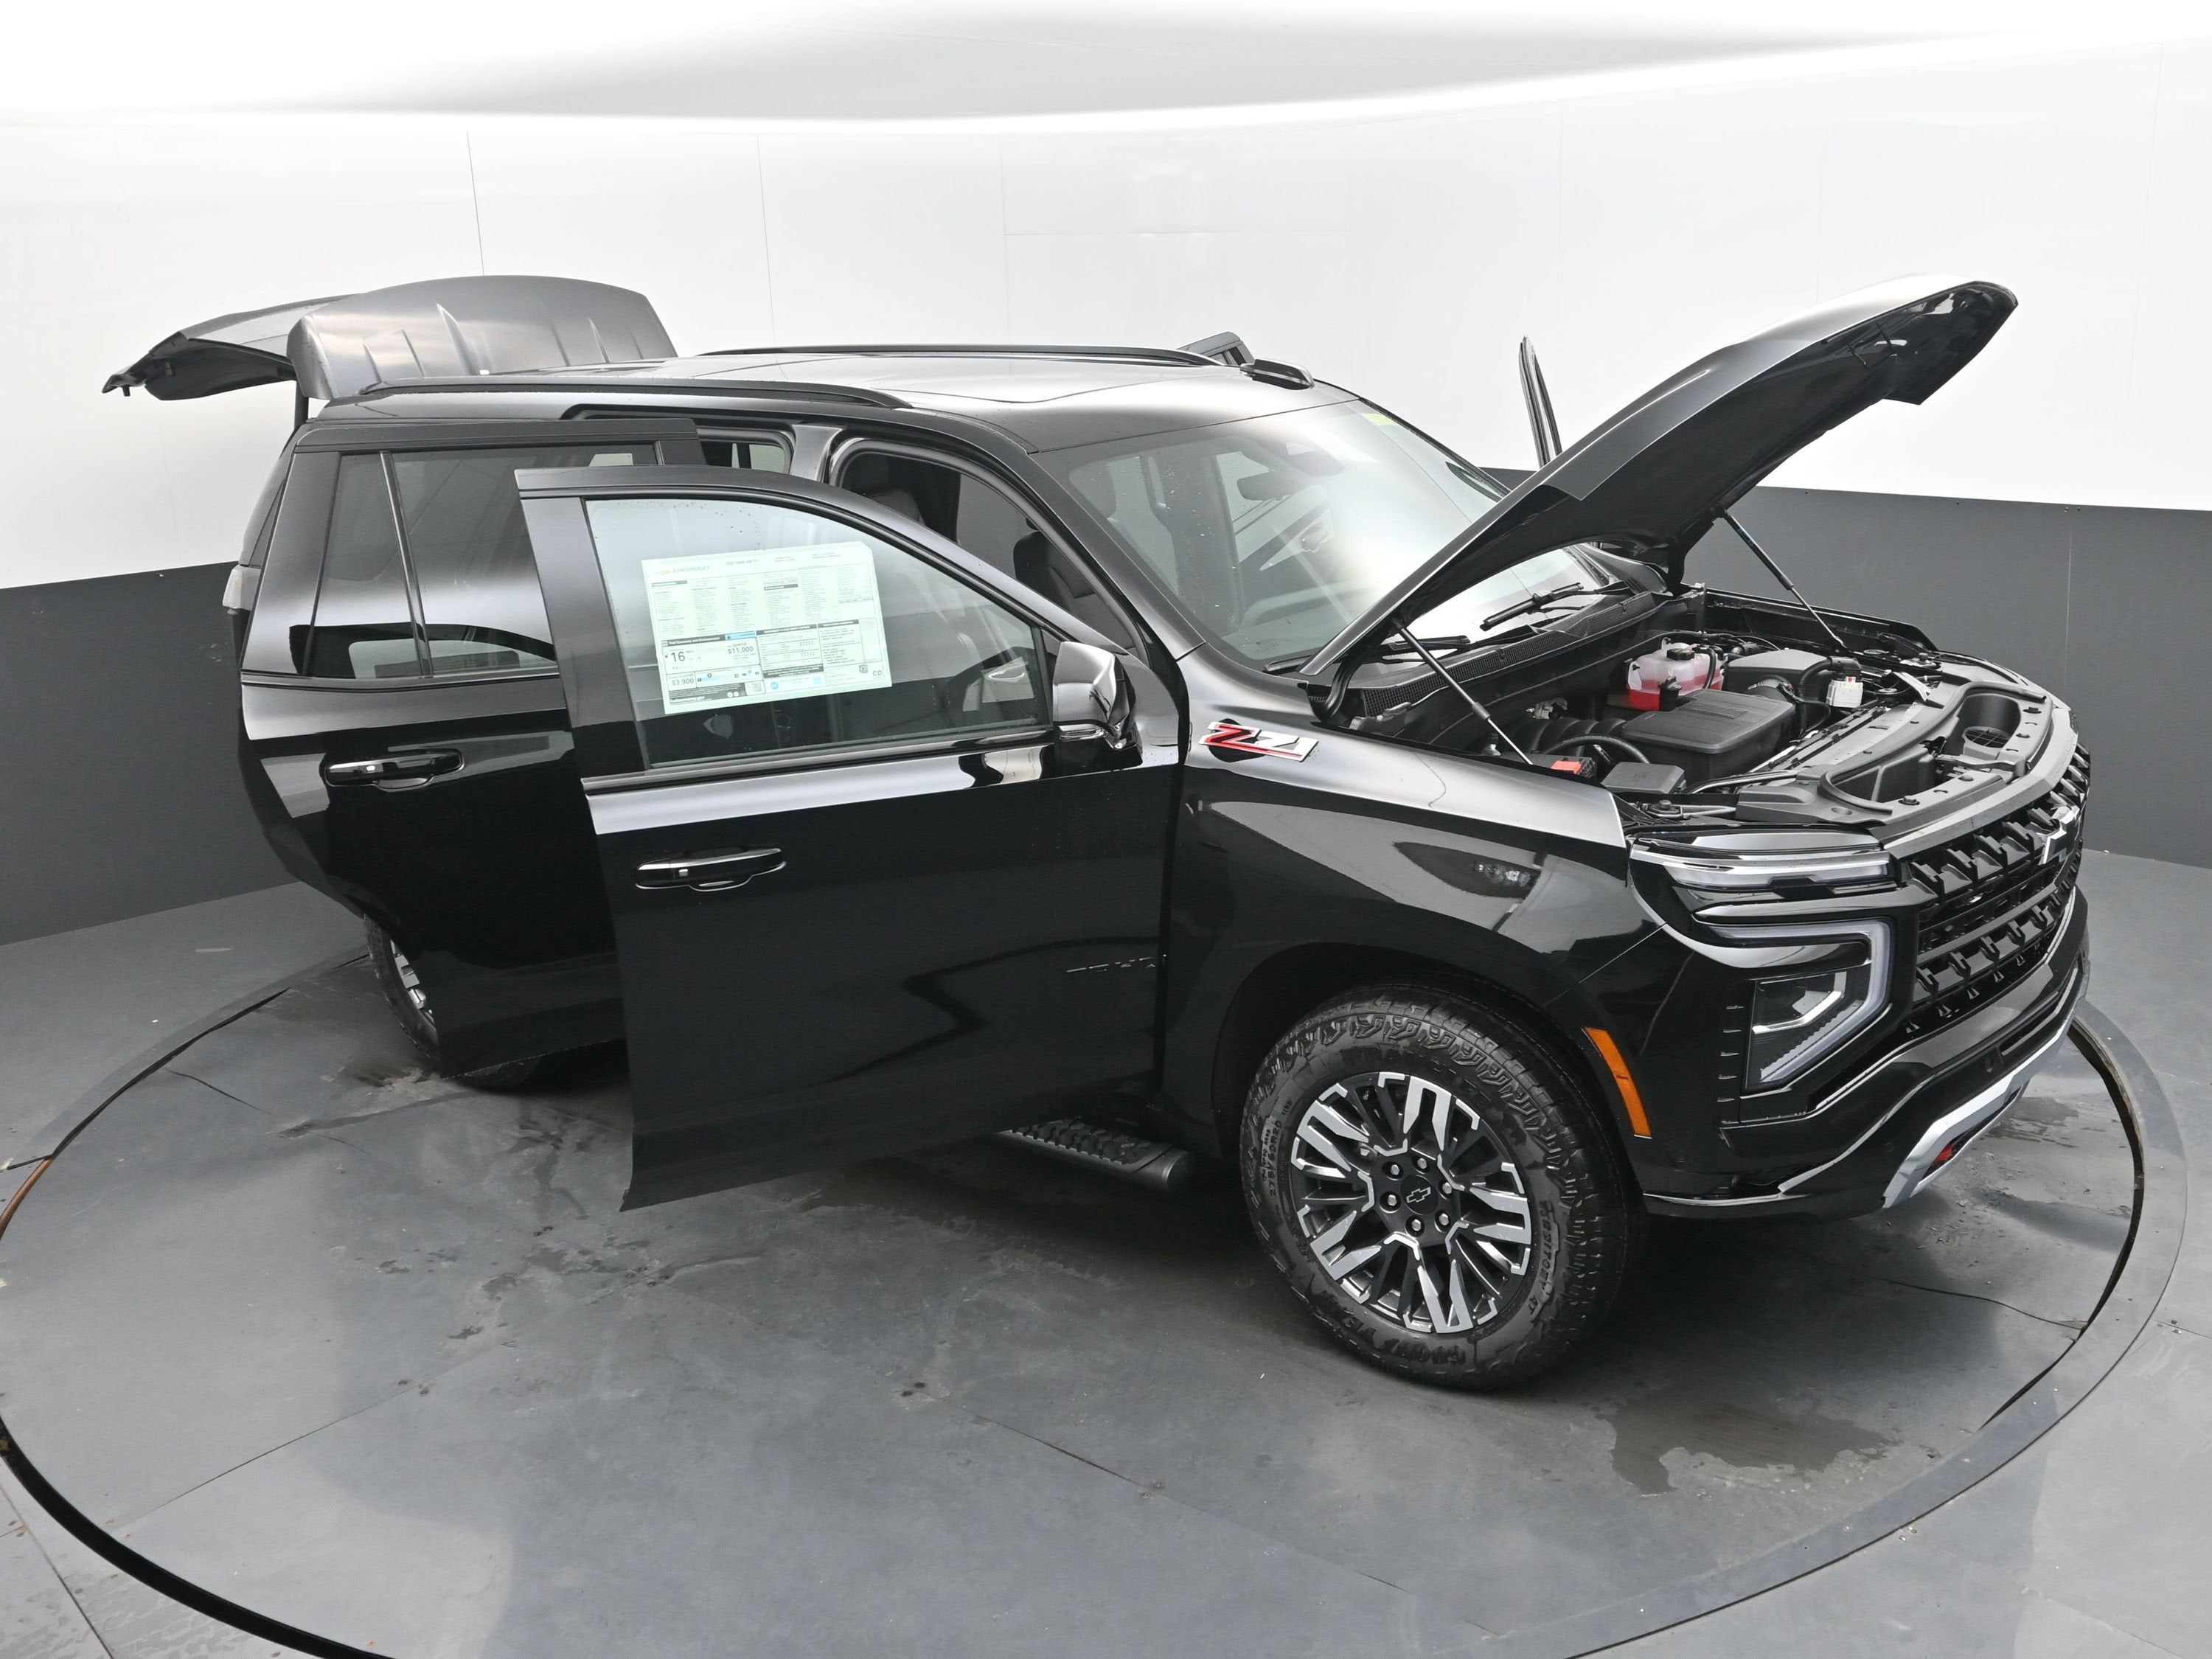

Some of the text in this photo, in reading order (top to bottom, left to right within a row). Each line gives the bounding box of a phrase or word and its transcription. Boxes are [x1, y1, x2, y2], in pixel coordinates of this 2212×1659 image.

[671, 651, 686, 662] 16
[727, 646, 754, 655] $11,000
[1198, 721, 1319, 762] Z71
[1267, 1120, 1281, 1197] 275/60R20
